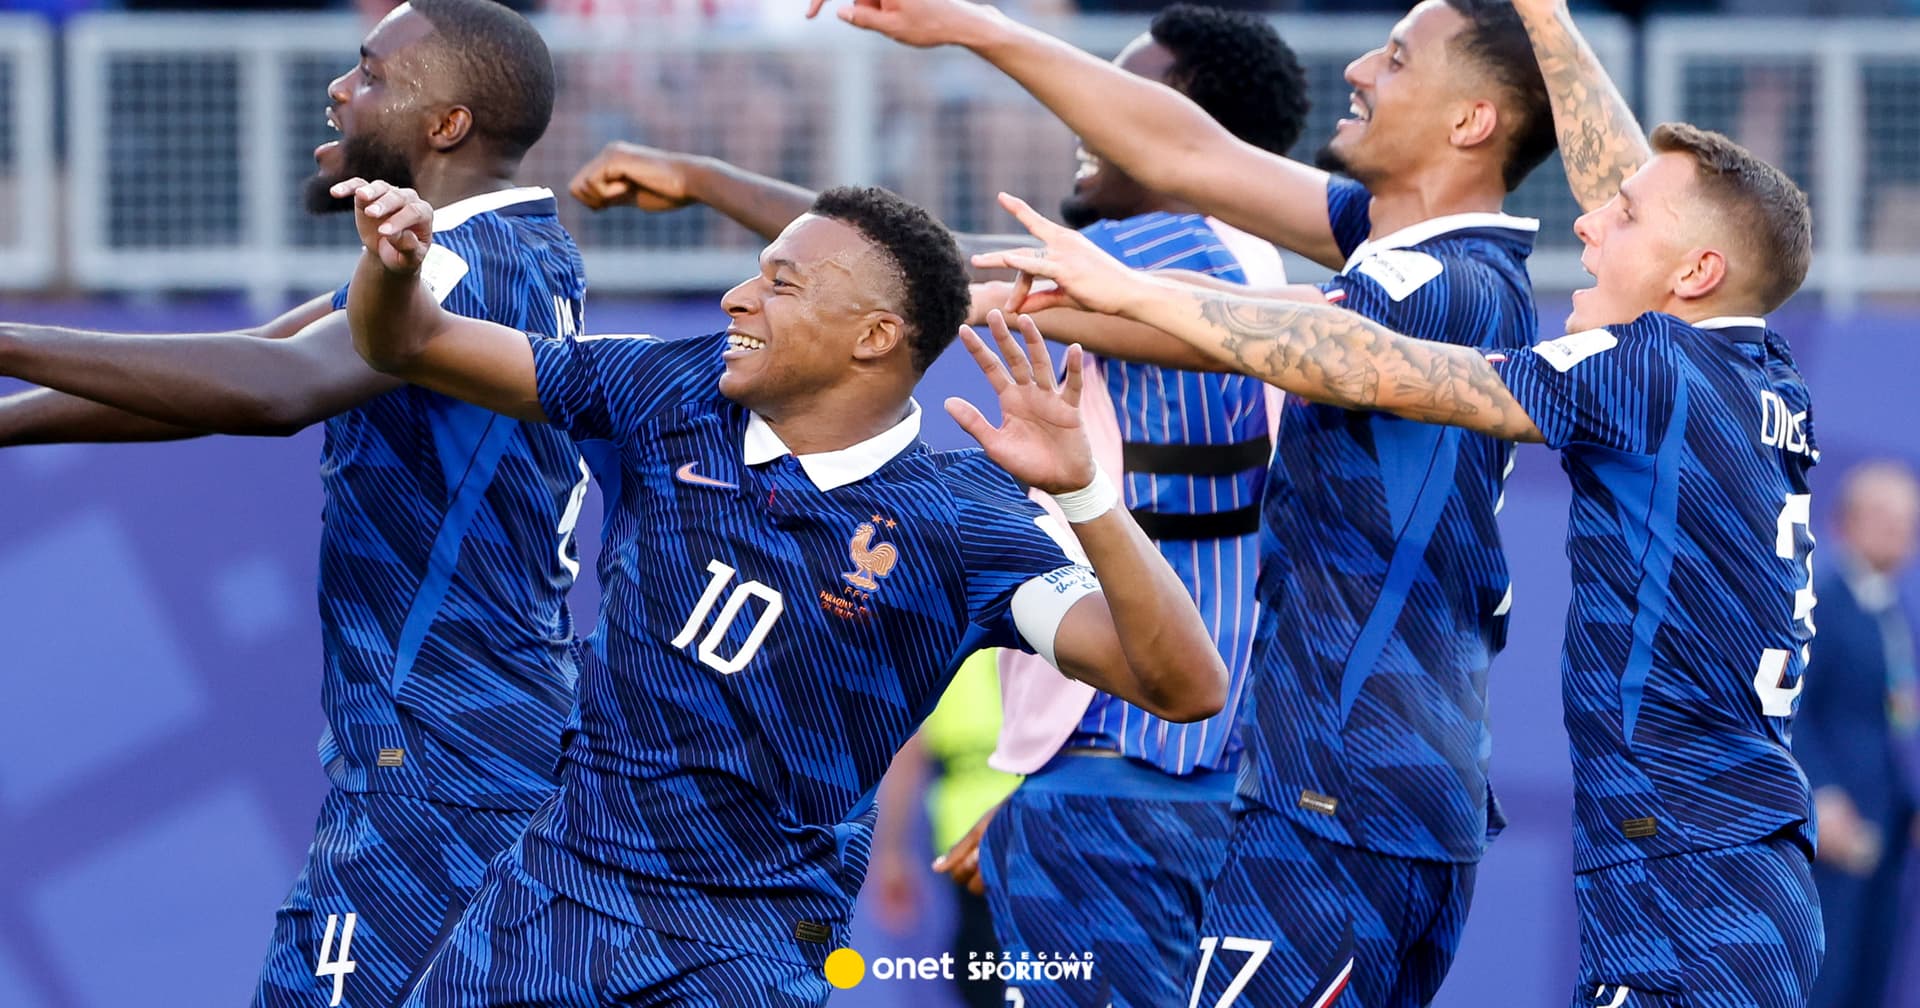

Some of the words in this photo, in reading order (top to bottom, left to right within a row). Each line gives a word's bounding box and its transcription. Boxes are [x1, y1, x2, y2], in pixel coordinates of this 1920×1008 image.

[670, 558, 784, 675] 10
[315, 912, 357, 1007] 4
[1188, 936, 1273, 1008] 17
